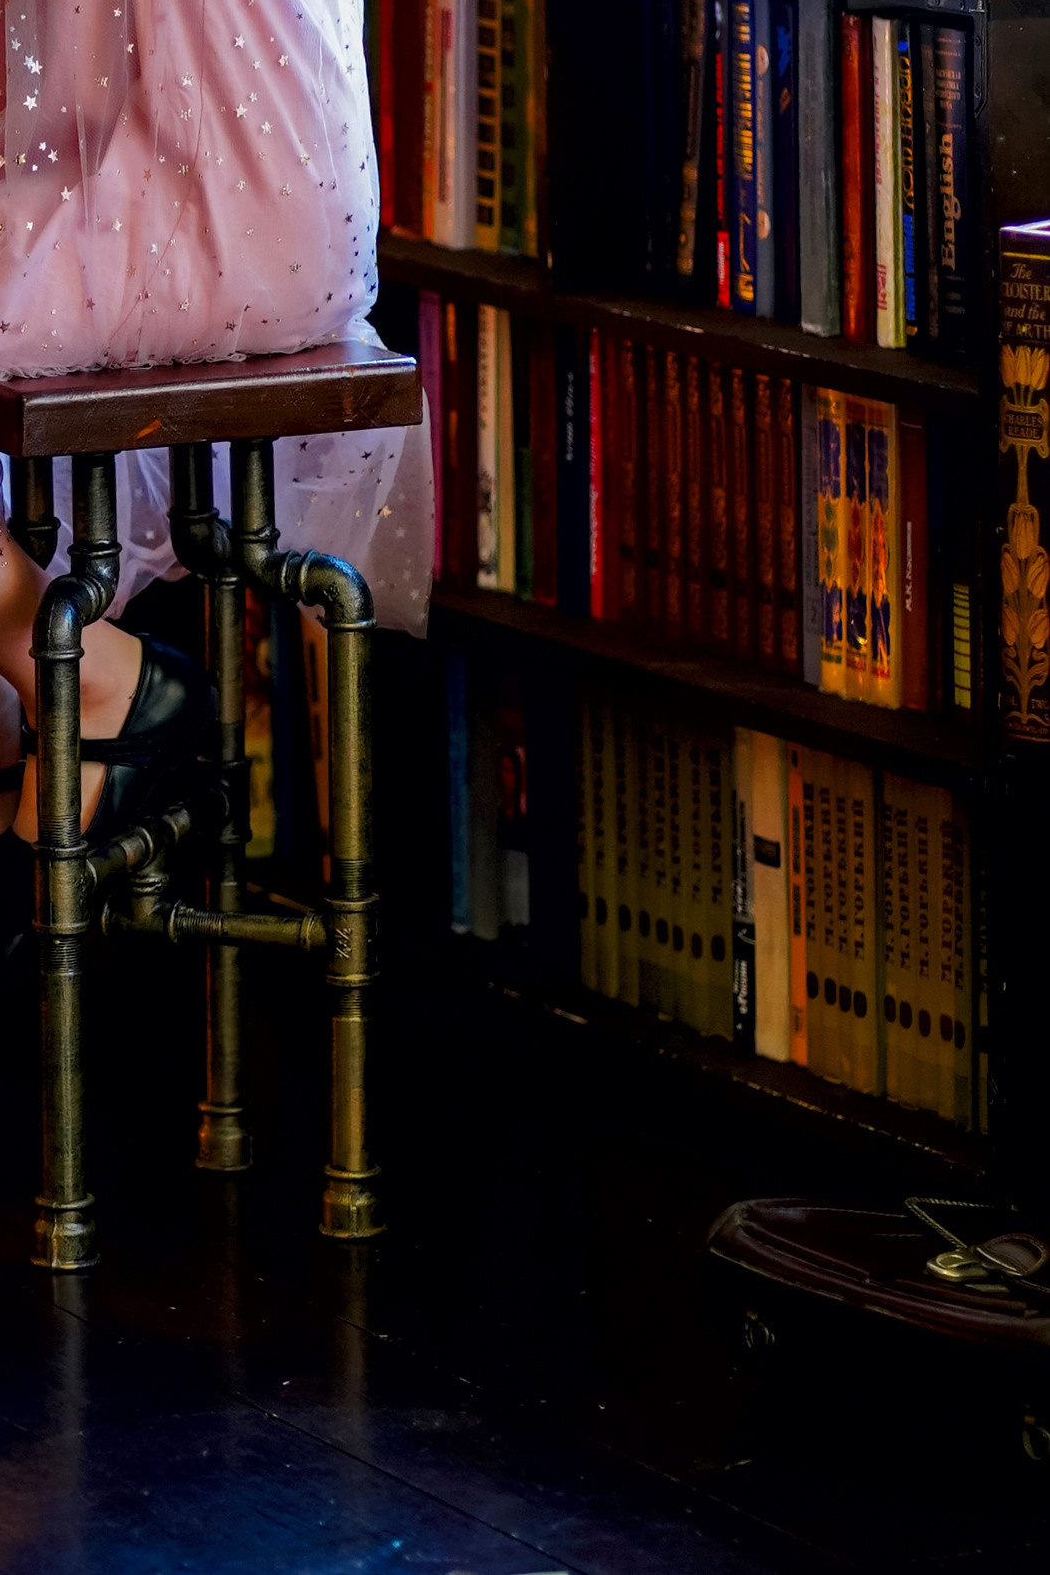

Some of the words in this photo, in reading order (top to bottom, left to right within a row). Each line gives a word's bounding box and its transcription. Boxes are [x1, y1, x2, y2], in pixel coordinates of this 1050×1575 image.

[939, 133, 962, 271] English
[1004, 304, 1026, 318] and
[1028, 303, 1046, 321] the
[1010, 263, 1032, 280] The
[853, 799, 864, 925] ГОРЬКИЙ
[894, 808, 910, 935] ГОРЬКИЙ
[915, 817, 928, 944] ГОРЬКИЙ
